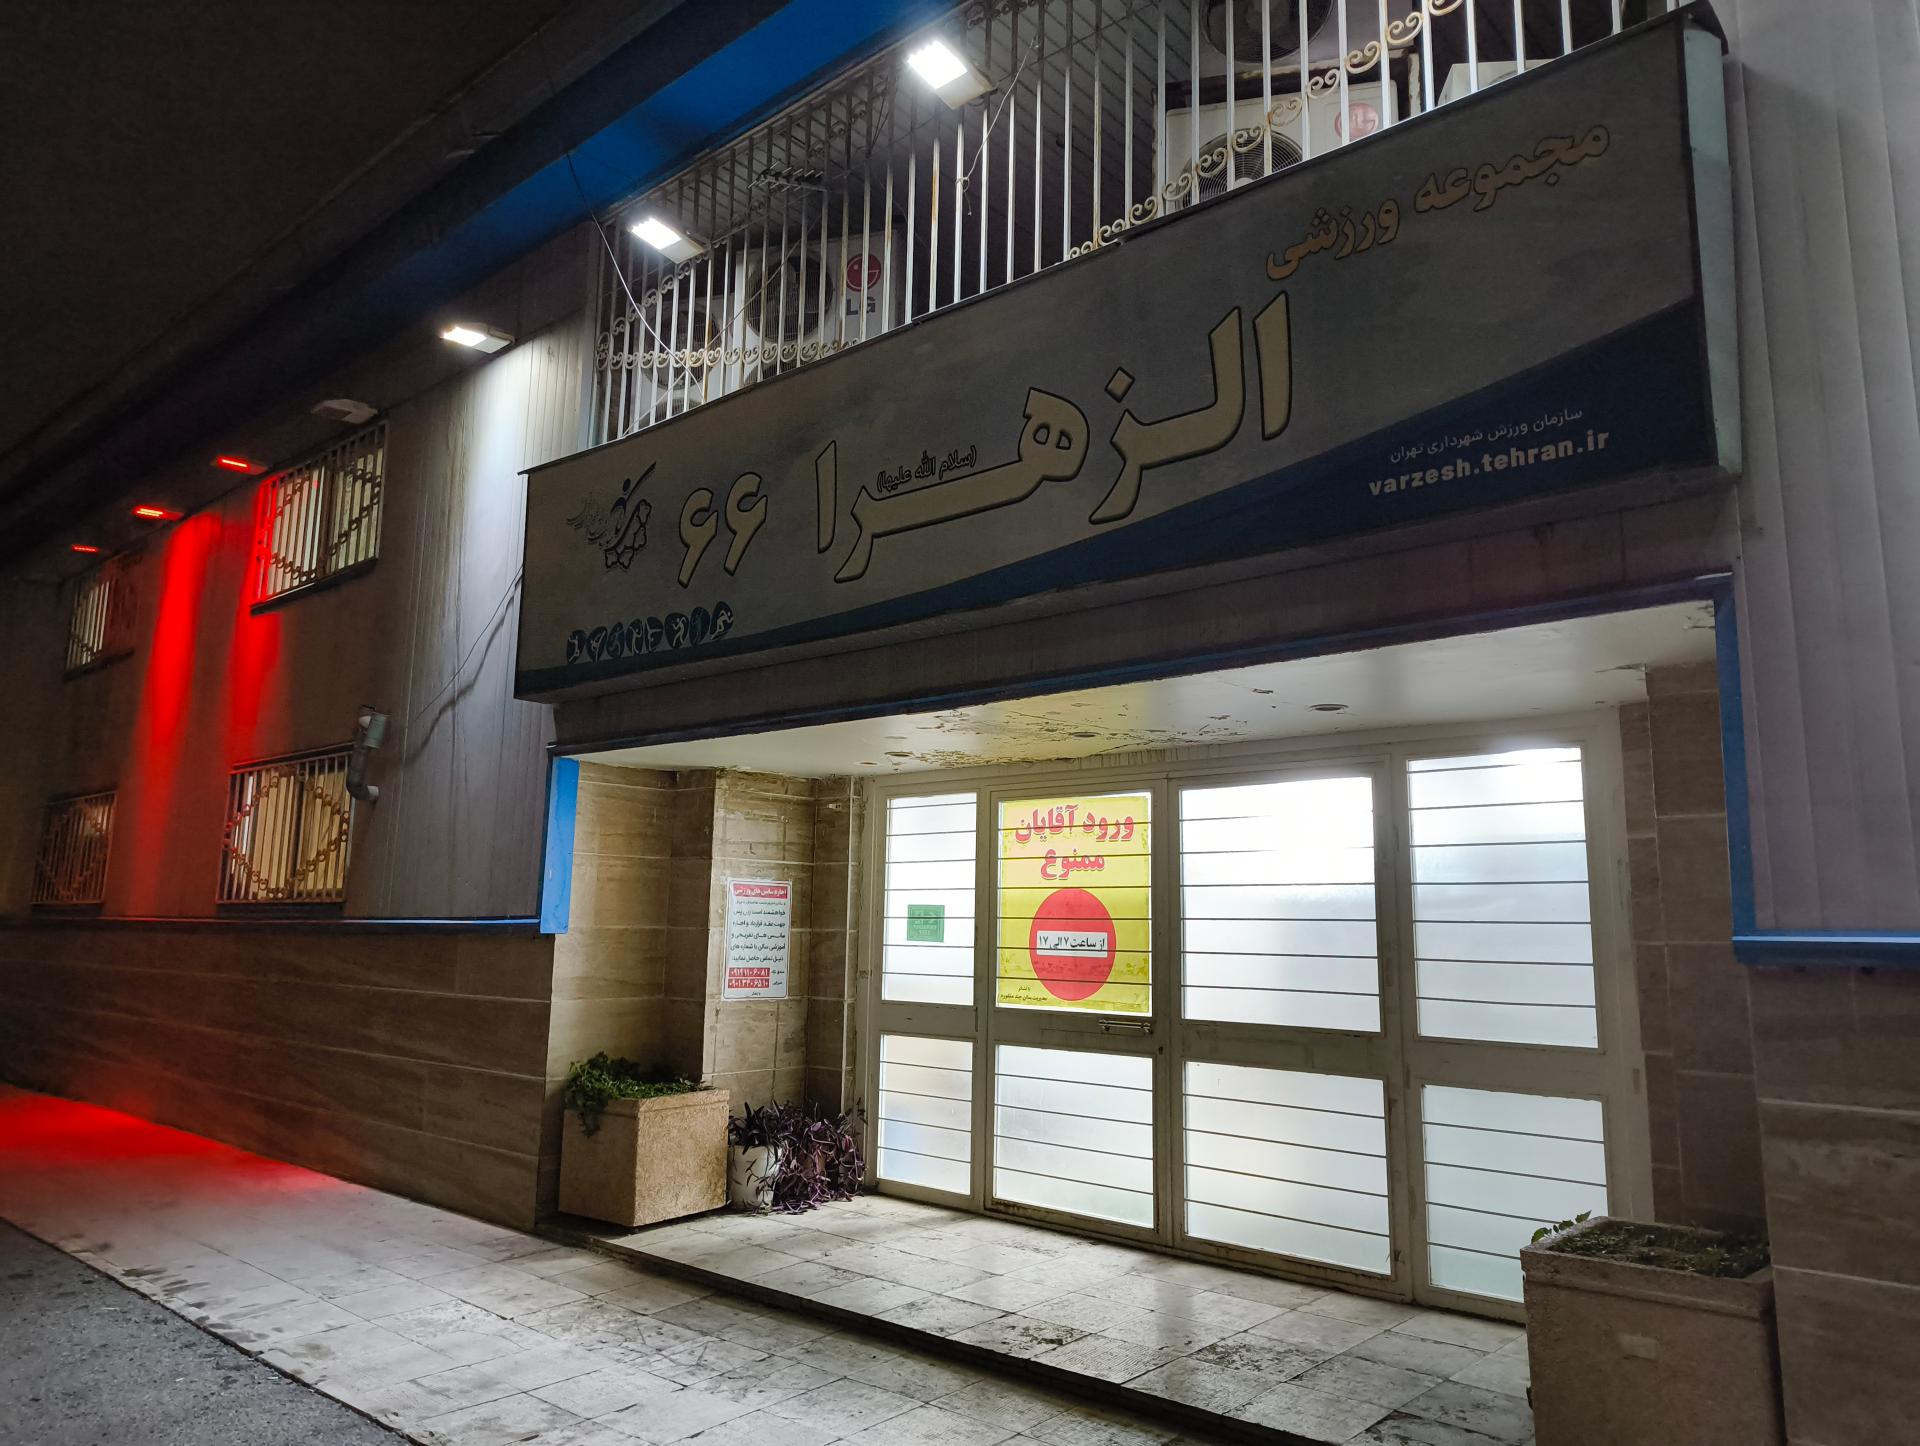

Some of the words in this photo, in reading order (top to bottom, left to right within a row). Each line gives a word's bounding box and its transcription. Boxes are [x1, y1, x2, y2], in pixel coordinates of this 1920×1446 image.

[1413, 124, 1610, 213] مجموعه
[1266, 198, 1400, 281] ورزشی
[846, 296, 876, 316] LG
[1487, 421, 1528, 442] ورزش
[1533, 408, 1583, 432] سازمان
[815, 290, 1293, 583] الزهرا
[1426, 429, 1484, 456] شهرداری
[1368, 429, 1610, 496] varzesh.tehran.ir
[1390, 444, 1423, 463] تهران
[677, 471, 768, 589] ۶۶
[1015, 804, 1079, 844] آقایان
[1083, 812, 1135, 842] ورود
[1041, 849, 1105, 880] ممنوع
[1099, 938, 1105, 951] از
